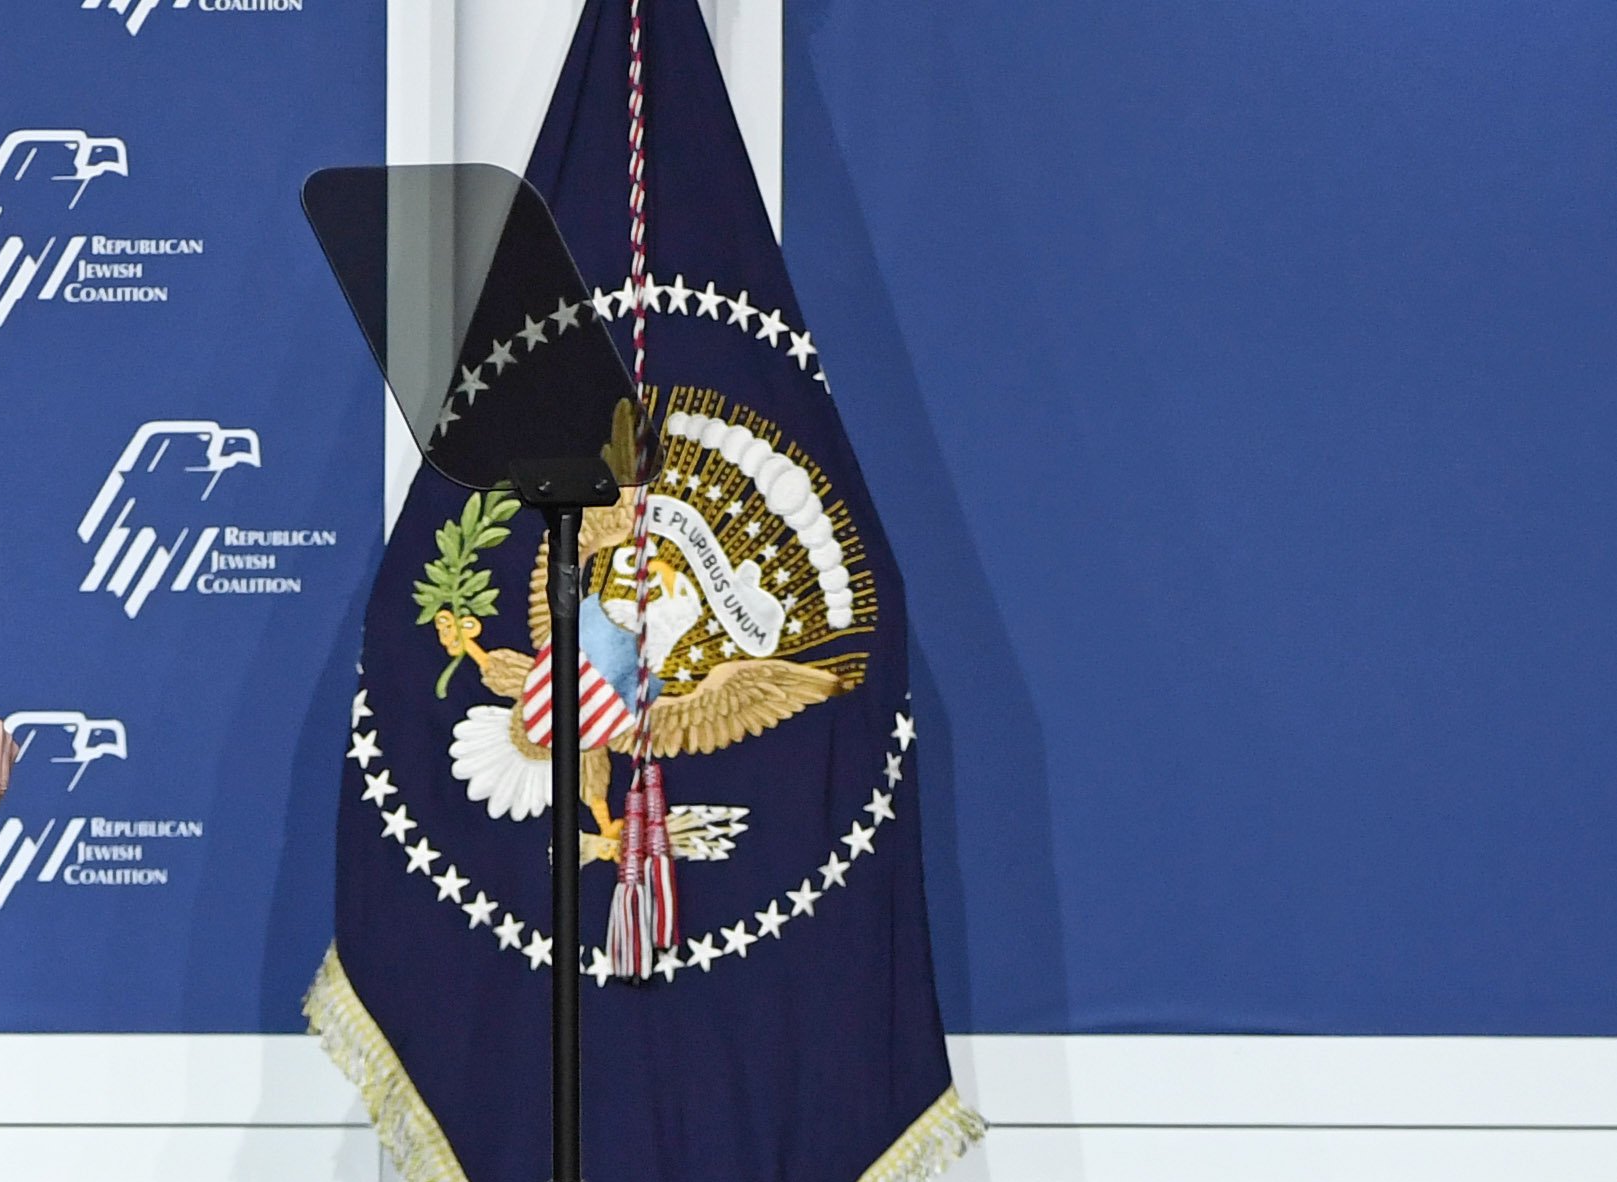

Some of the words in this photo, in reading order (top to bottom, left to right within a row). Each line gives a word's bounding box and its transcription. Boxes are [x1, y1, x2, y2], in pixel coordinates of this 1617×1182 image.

[91, 235, 203, 254] REPUBLICAN
[77, 259, 143, 281] JEWISH
[64, 283, 168, 302] COALITION
[224, 526, 336, 546] REPUBLICAN
[211, 550, 276, 573] JEWISH
[196, 573, 301, 594] COALITION
[653, 506, 663, 523] E
[668, 510, 730, 593] PLURIBUS
[723, 593, 767, 646] UNUM
[90, 817, 203, 837] REPUBLICAN
[77, 841, 142, 864] JEWISH
[63, 865, 168, 885] COALITION
